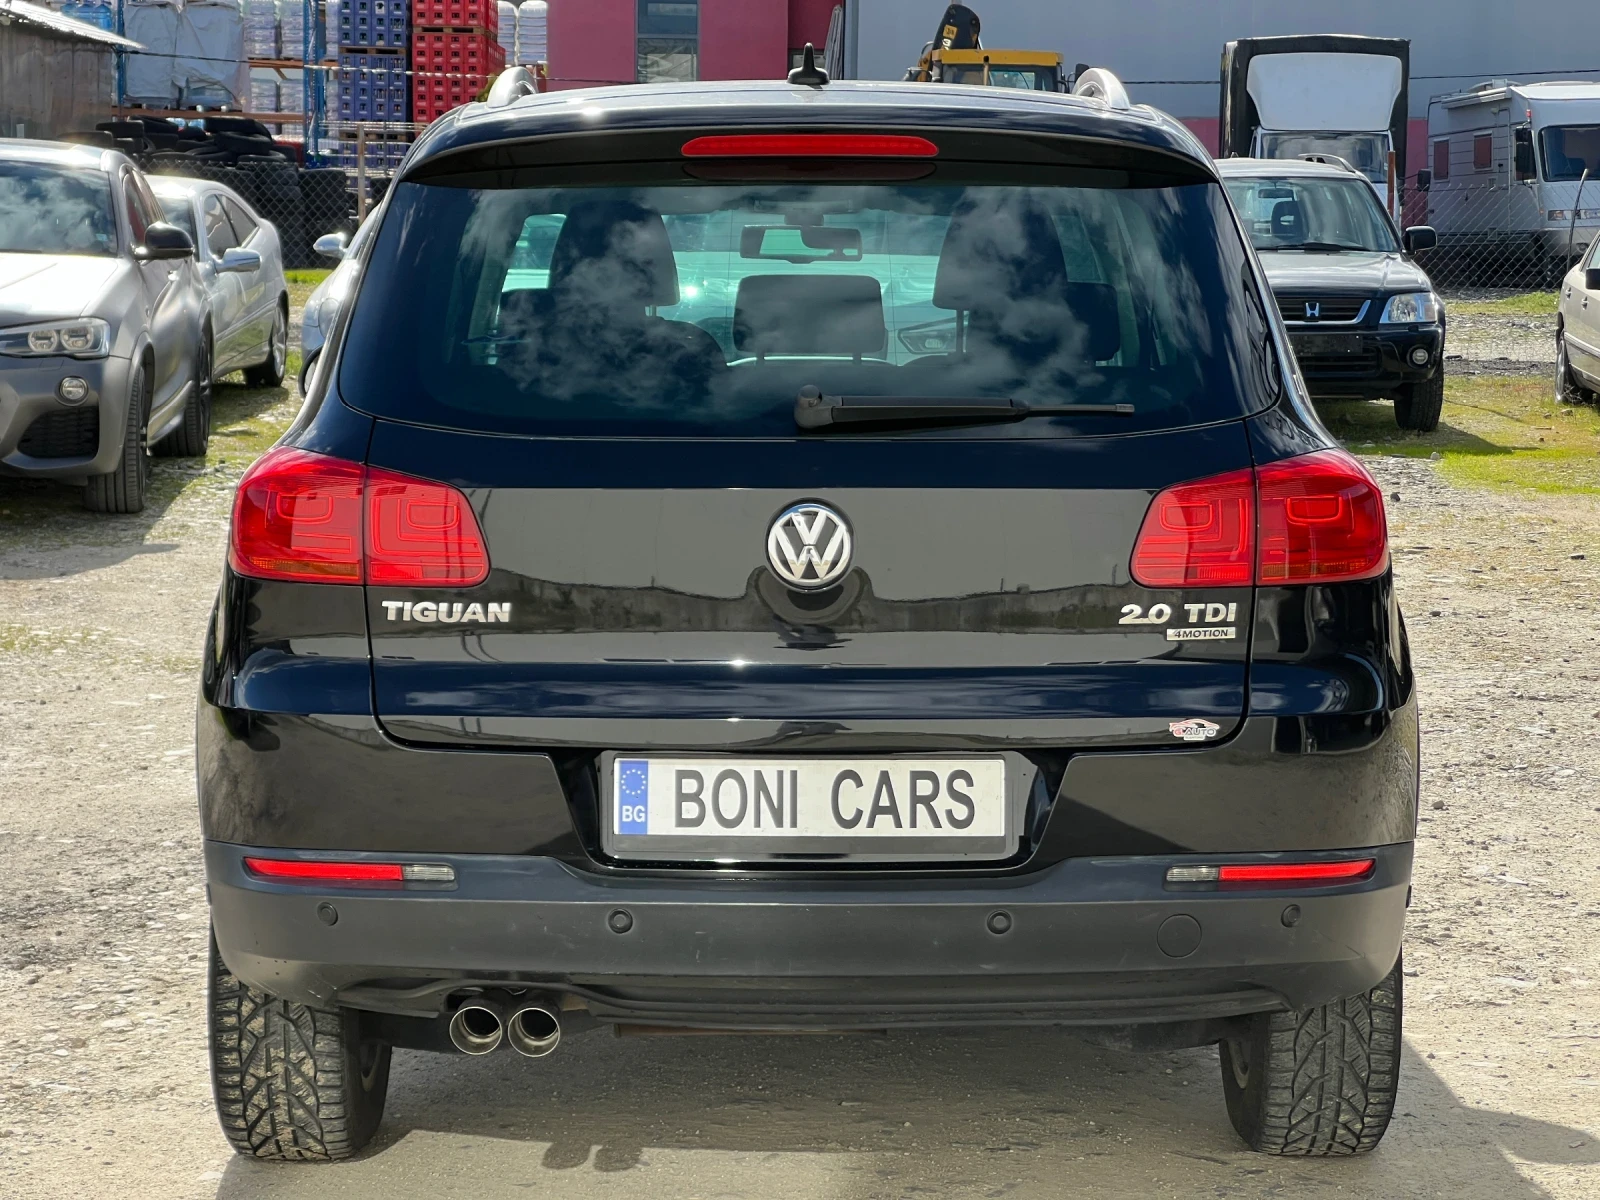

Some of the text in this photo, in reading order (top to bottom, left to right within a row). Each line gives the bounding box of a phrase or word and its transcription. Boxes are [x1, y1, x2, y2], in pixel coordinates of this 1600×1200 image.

[381, 600, 511, 623] TIGUAN
[1184, 602, 1237, 623] TDI
[1173, 629, 1228, 638] 4MOTION
[675, 769, 976, 830] BONI CARS
[622, 805, 646, 823] BG
